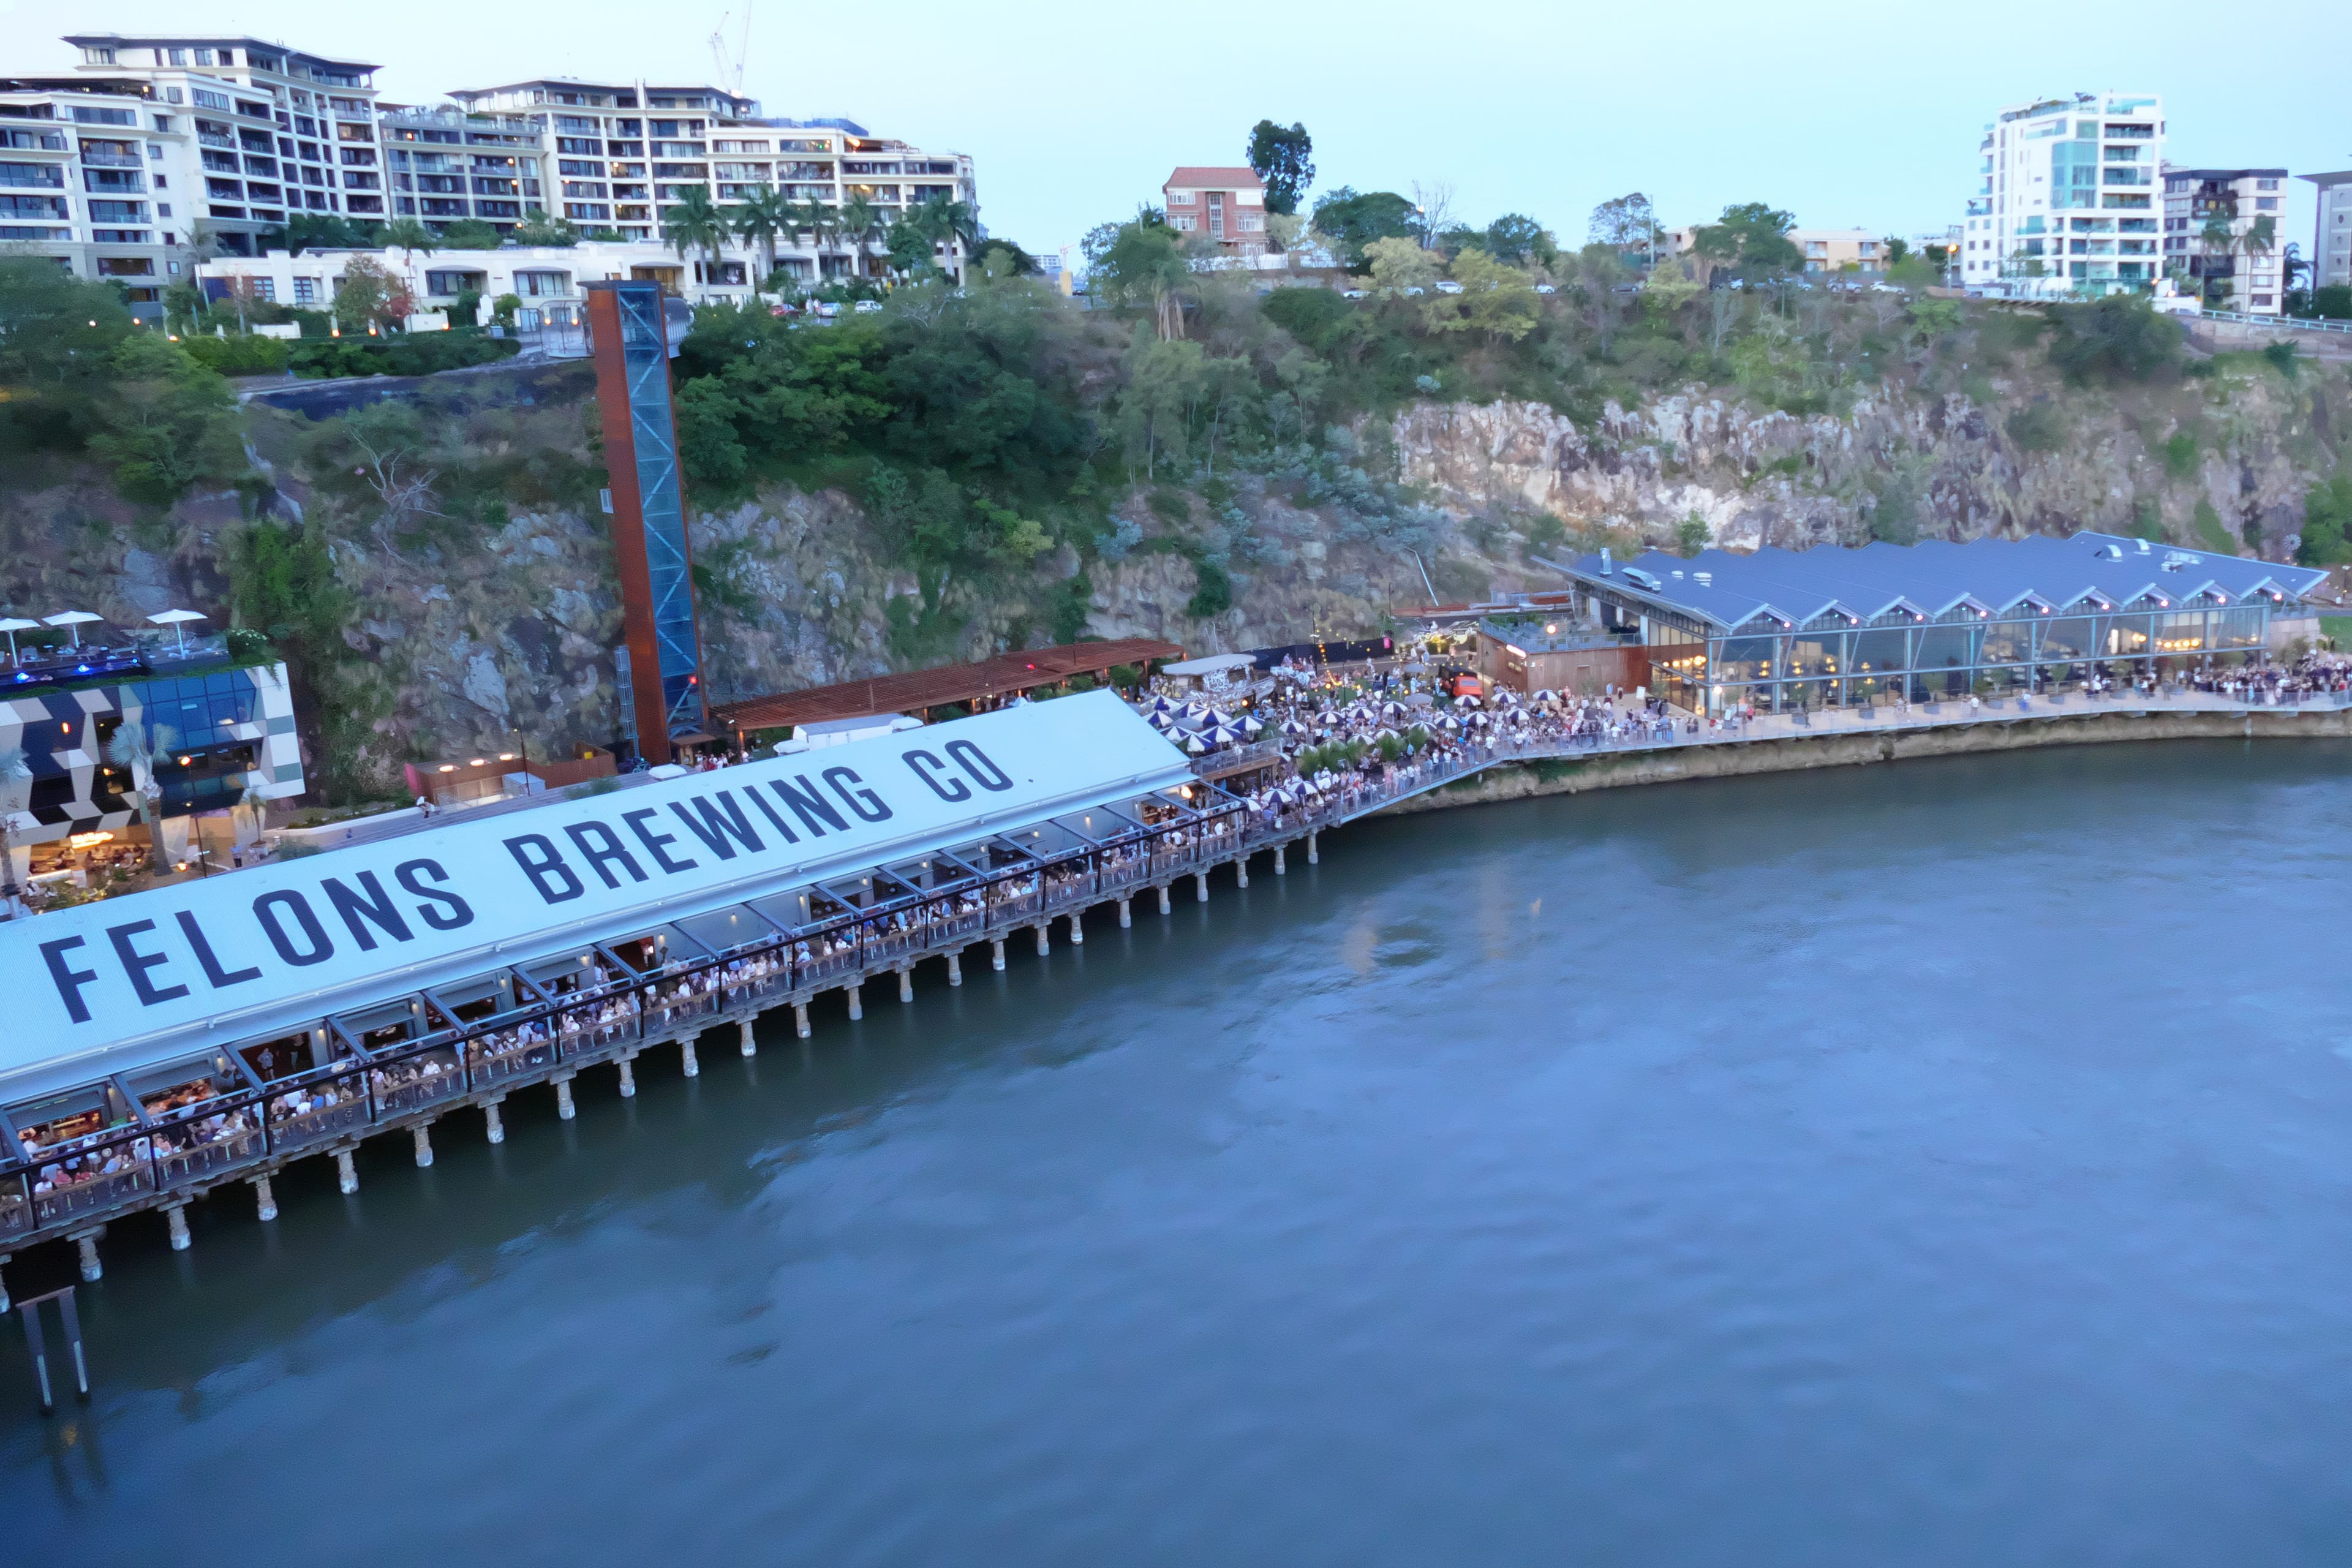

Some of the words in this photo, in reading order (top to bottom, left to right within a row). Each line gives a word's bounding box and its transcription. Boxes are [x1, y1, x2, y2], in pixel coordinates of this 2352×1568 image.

[39, 858, 475, 1025] FELONS
[502, 766, 894, 905] BREWING
[902, 739, 1014, 803] CO
